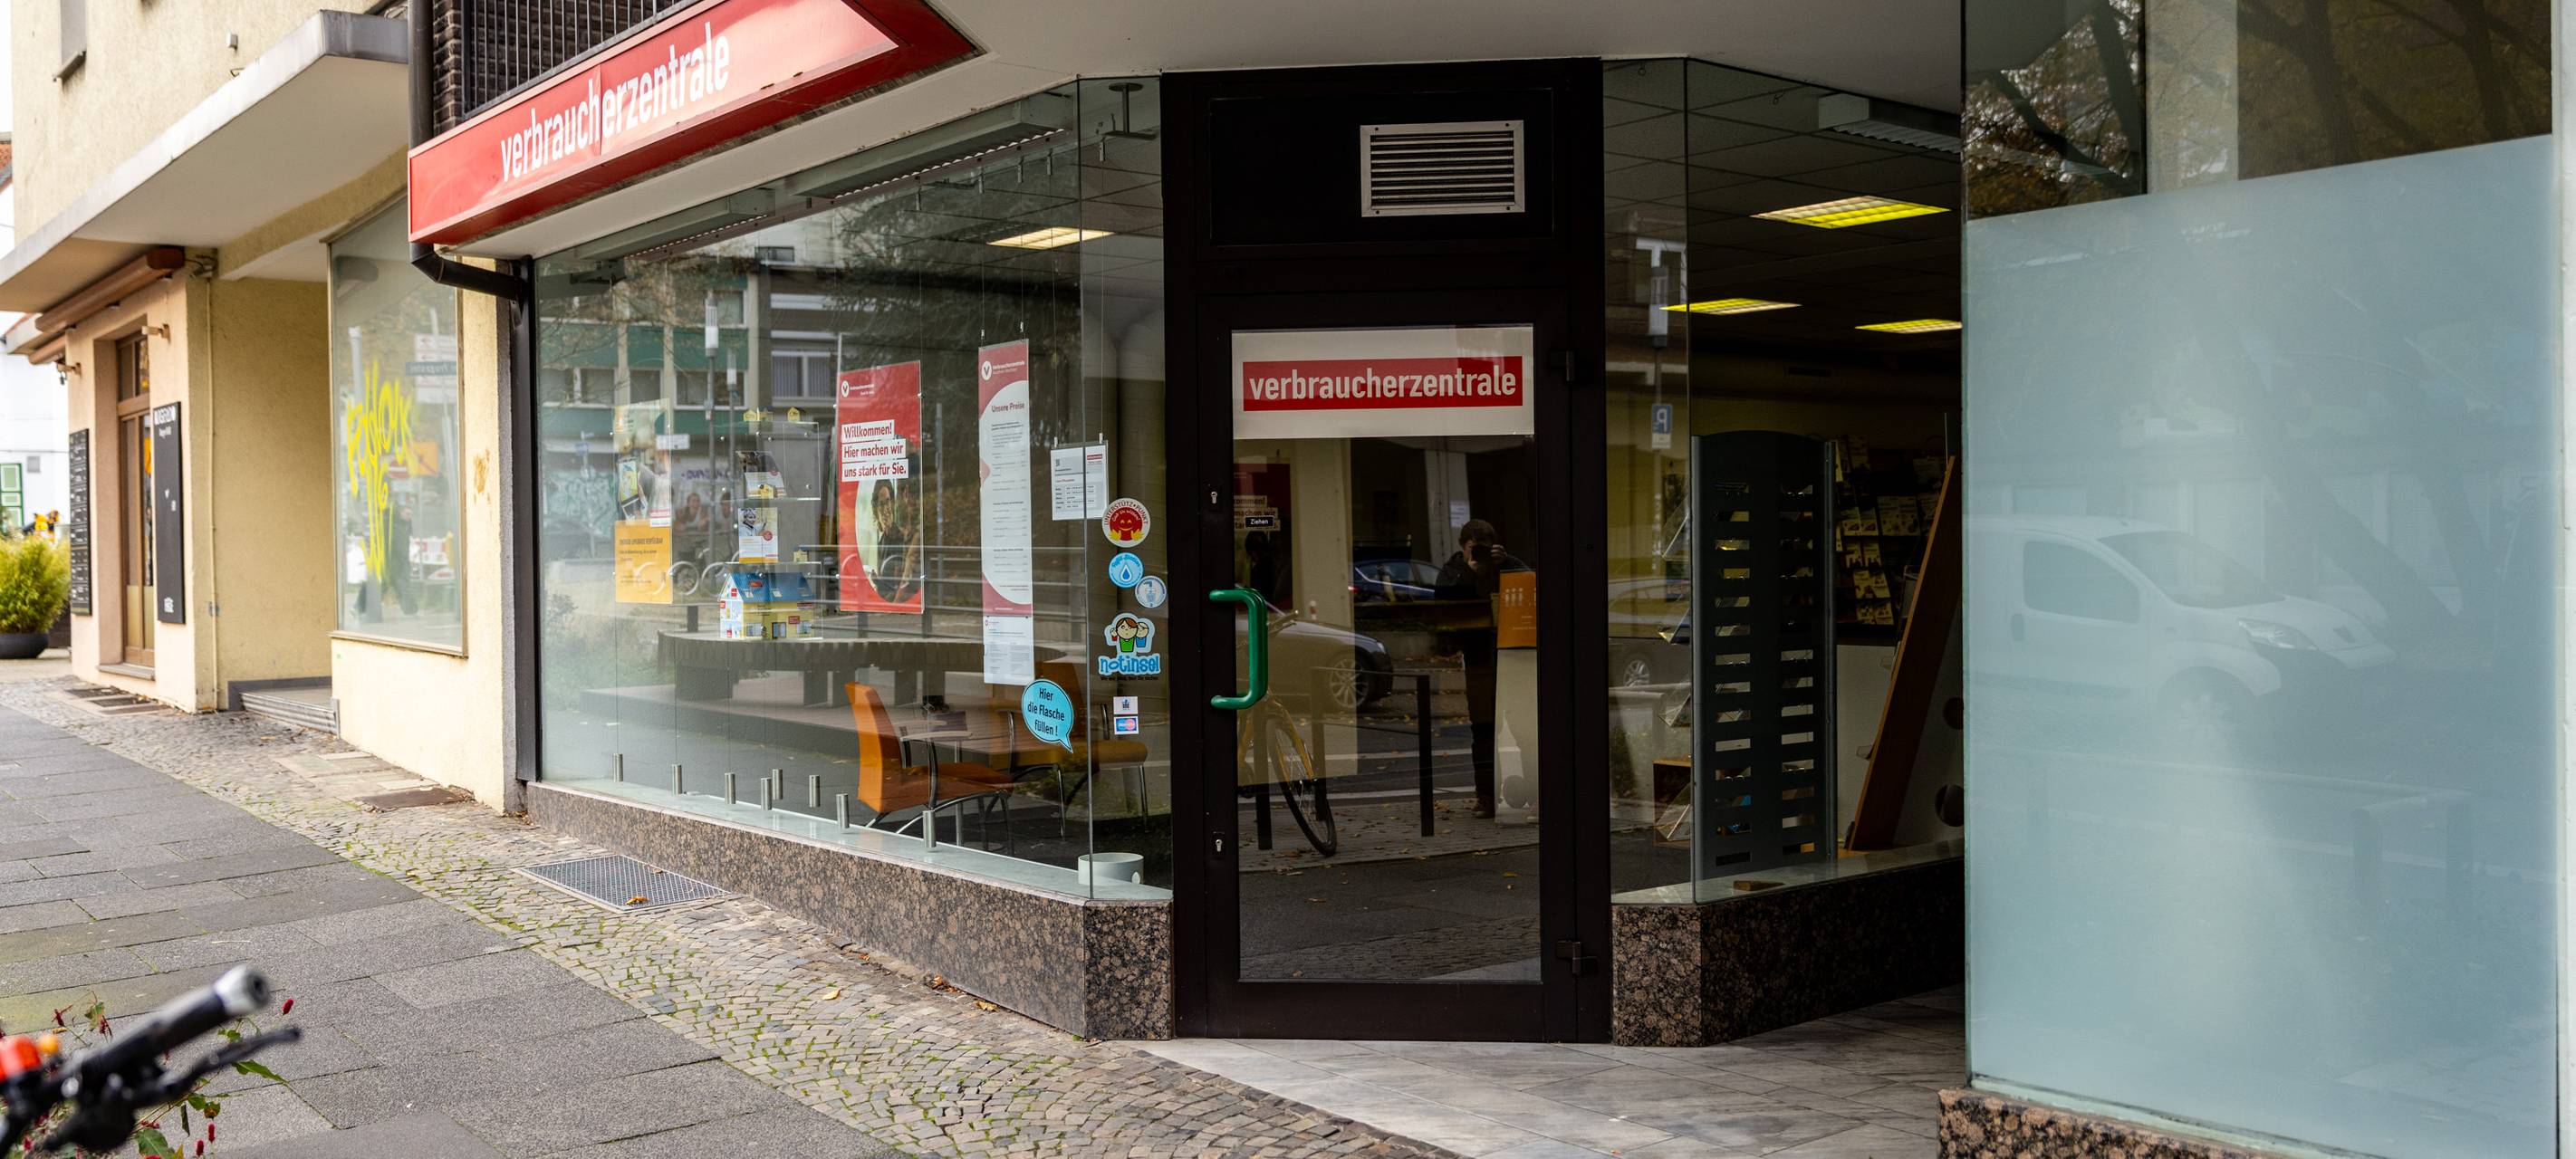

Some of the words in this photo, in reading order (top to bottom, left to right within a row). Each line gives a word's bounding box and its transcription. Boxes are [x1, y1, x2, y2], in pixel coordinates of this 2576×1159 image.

[501, 21, 730, 183] verbraucherzentrale
[1249, 367, 1516, 399] verbraucherzentrale
[992, 404, 1009, 413] Unsere
[843, 422, 892, 439] Willkommen!
[843, 445, 859, 458] Hier
[860, 444, 889, 457] machen
[890, 442, 904, 455] wir
[844, 467, 857, 477] uns
[858, 465, 877, 477] stark
[879, 463, 890, 475] für
[892, 461, 907, 474] Sie.
[1100, 656, 1160, 674] notinsel
[1039, 687, 1053, 702] Hier
[1027, 701, 1038, 714] die
[1039, 704, 1065, 722] Flasche
[1034, 719, 1054, 735] füllen
